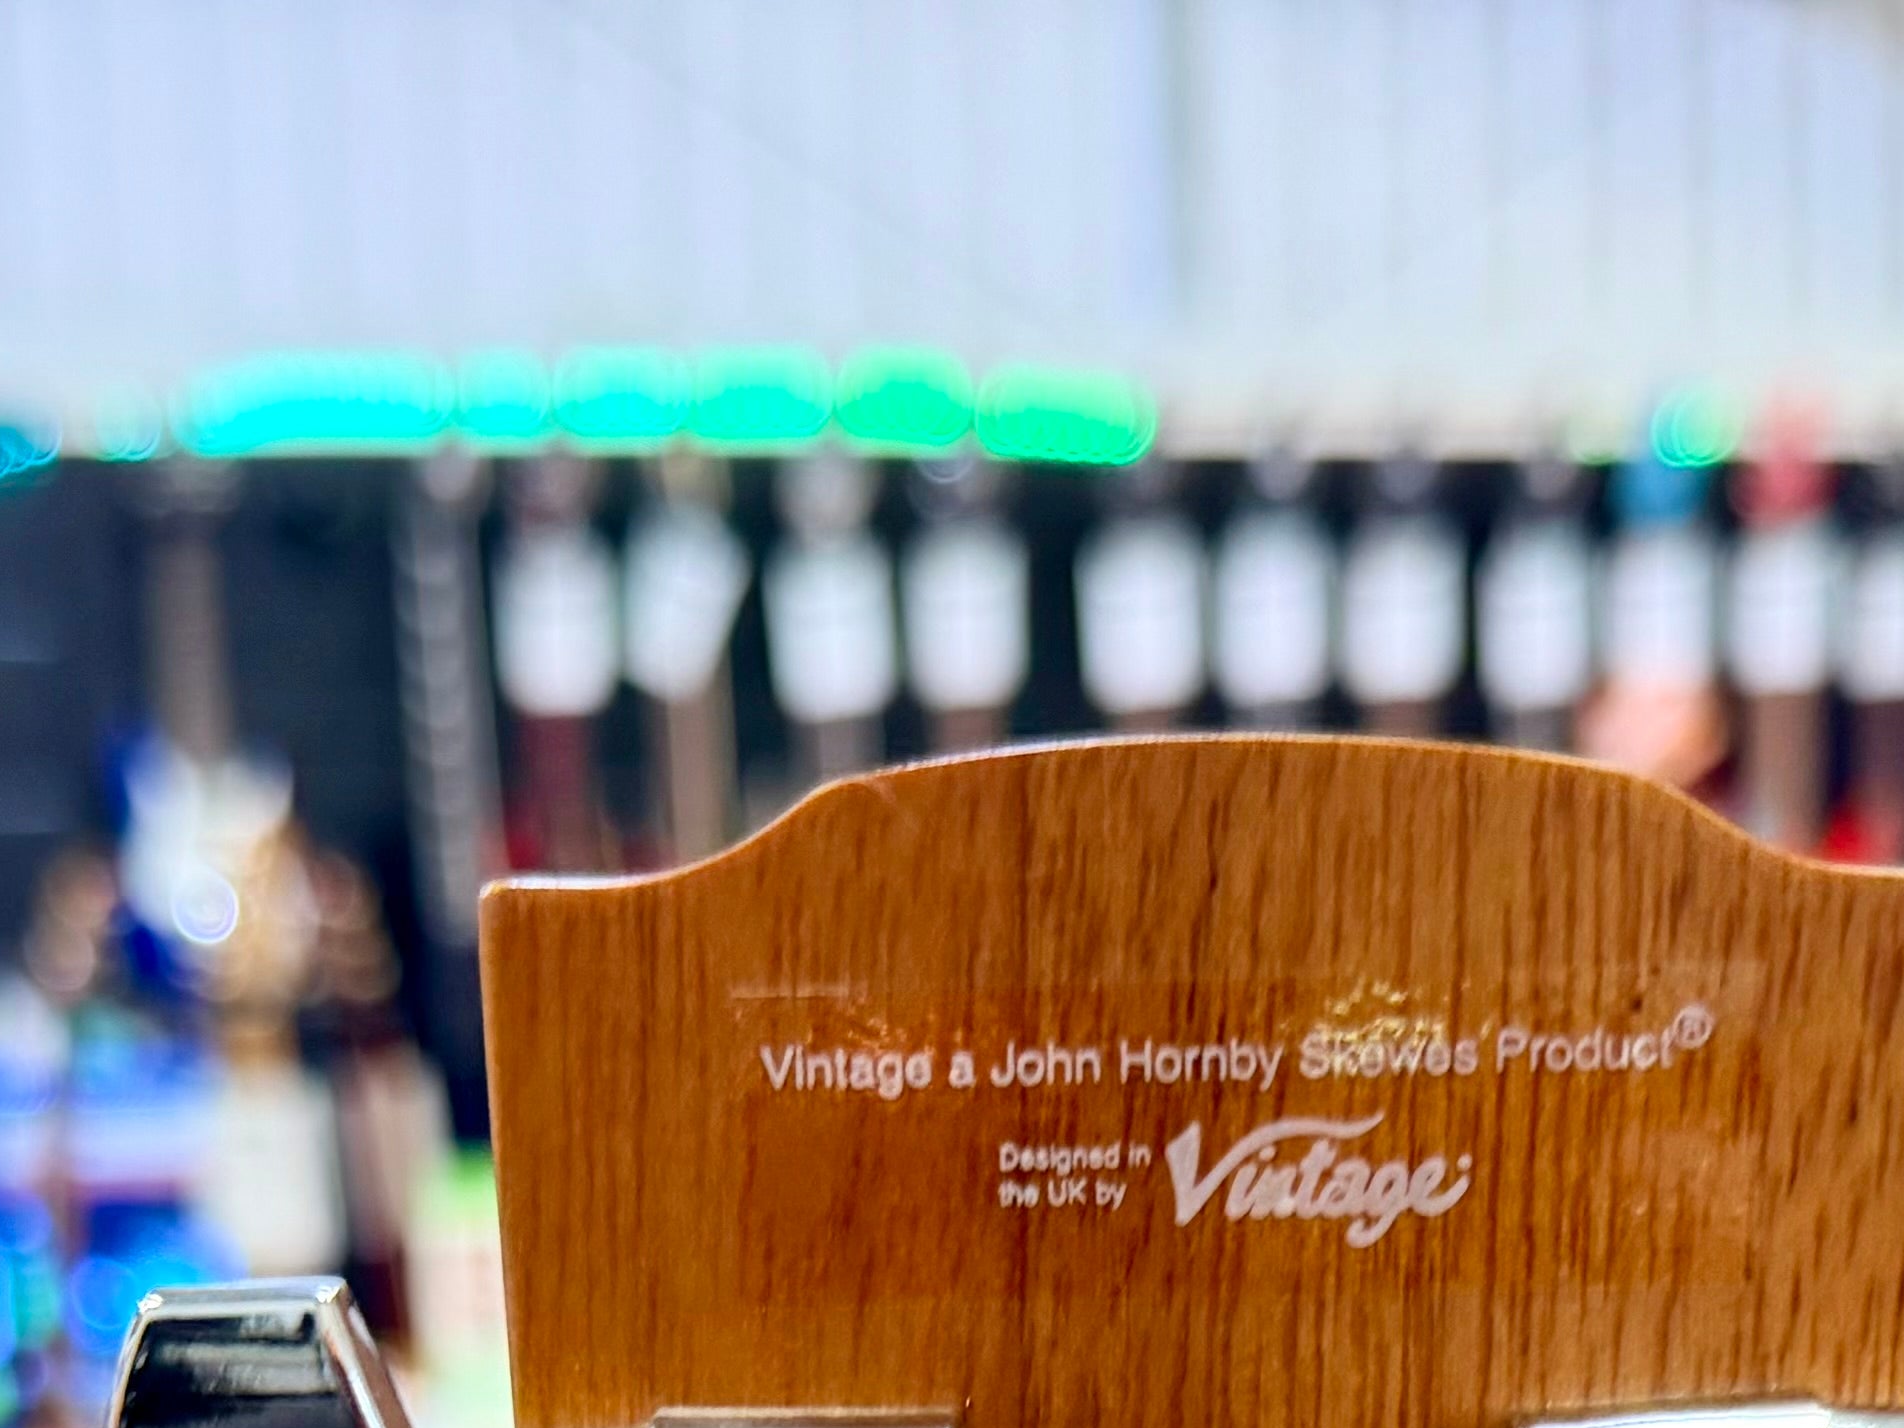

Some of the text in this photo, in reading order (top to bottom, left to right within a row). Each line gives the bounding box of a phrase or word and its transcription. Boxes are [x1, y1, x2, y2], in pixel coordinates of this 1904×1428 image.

[760, 1042, 933, 1101] Vintage
[948, 1050, 976, 1089] a
[990, 1038, 1102, 1088] John
[1120, 1034, 1284, 1092] Hornby
[1299, 1025, 1479, 1079] Skewes
[999, 1142, 1151, 1173] Designed in
[1164, 1110, 1473, 1249] Vintage
[998, 1180, 1127, 1211] the UK by
